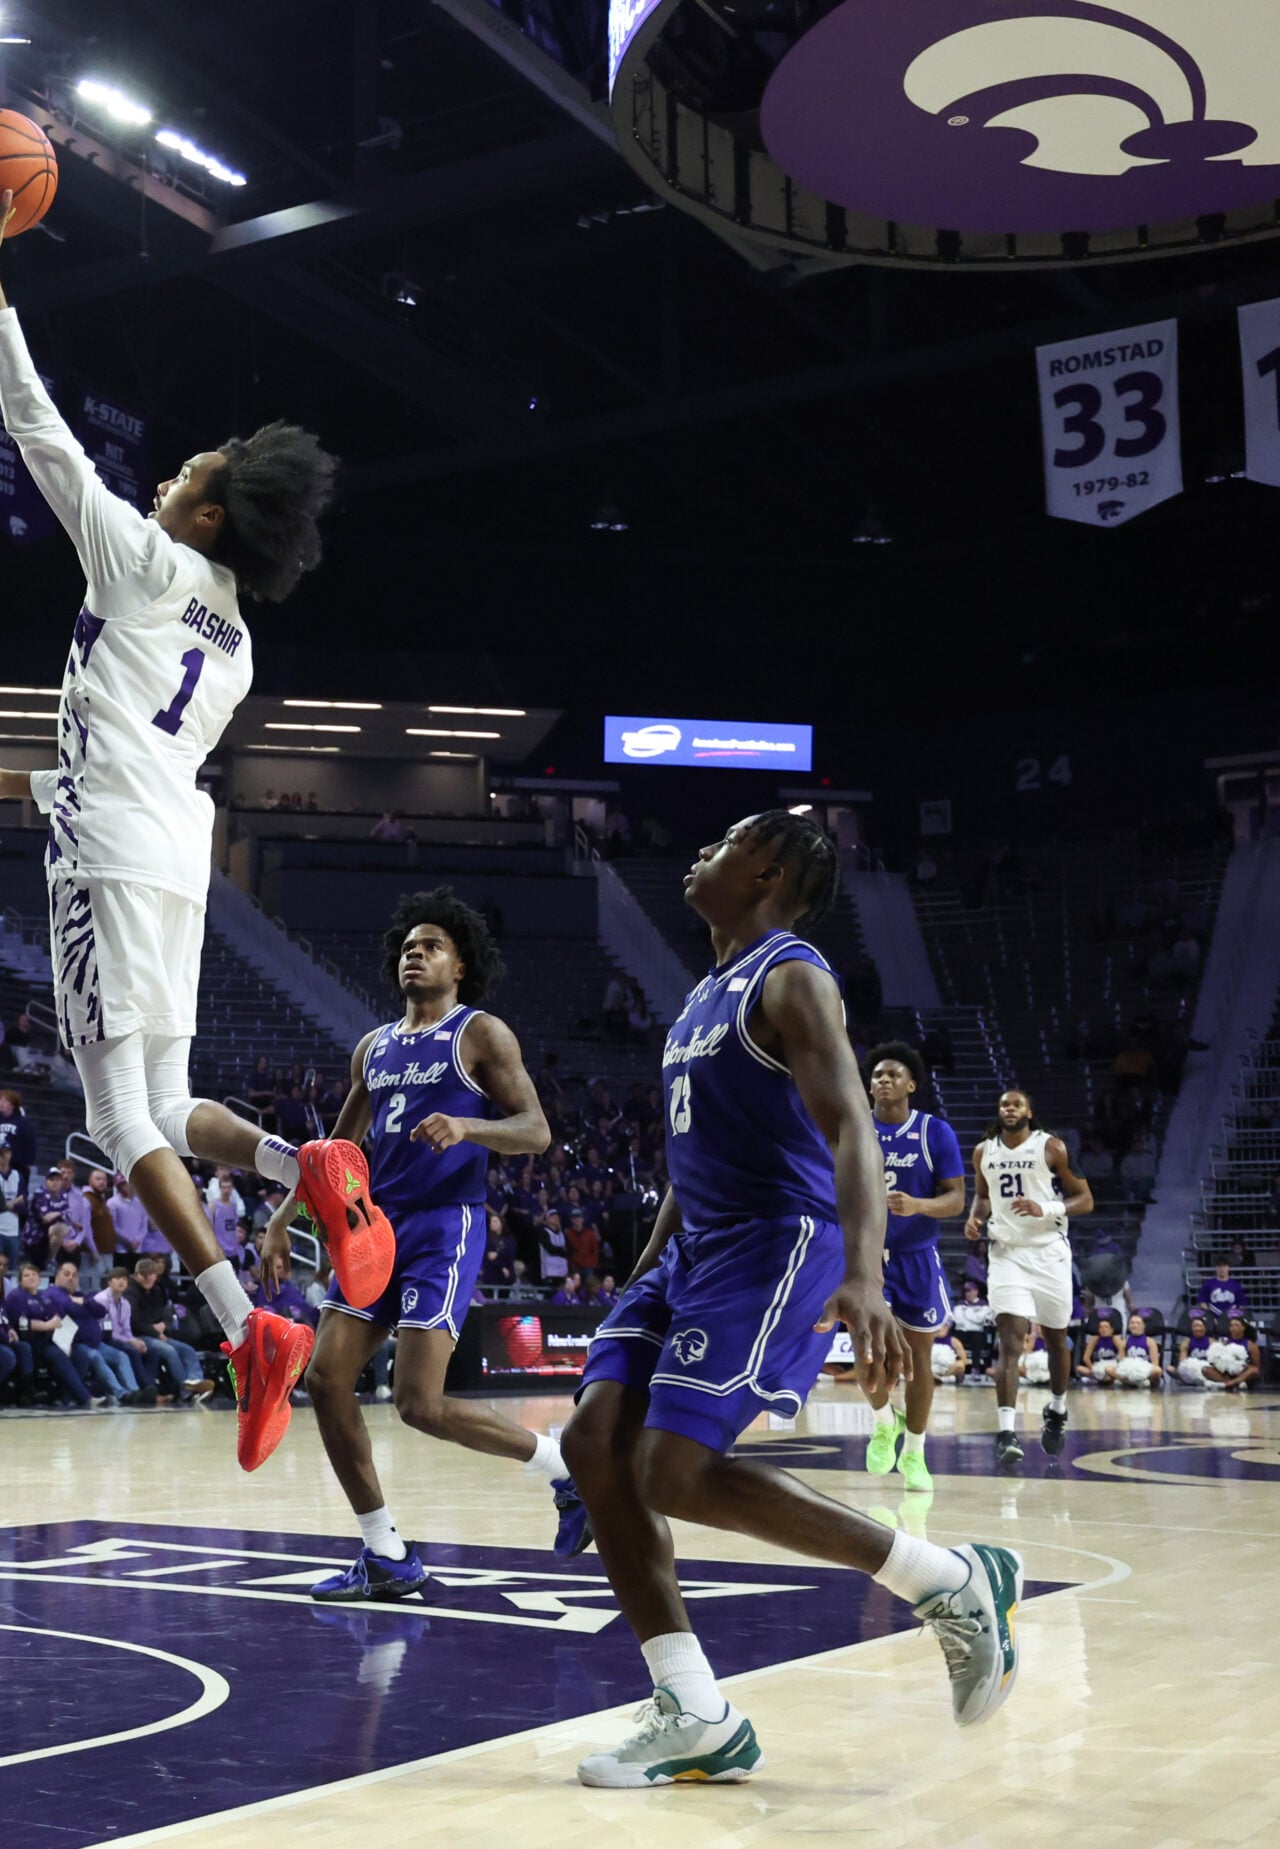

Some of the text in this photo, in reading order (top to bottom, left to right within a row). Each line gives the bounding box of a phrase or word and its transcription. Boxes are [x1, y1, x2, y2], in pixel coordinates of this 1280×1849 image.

[1049, 338, 1164, 377] ROMSTAD
[83, 395, 145, 437] K-STATE
[1053, 371, 1167, 468] 33
[1073, 471, 1150, 497] 1979-82
[181, 597, 243, 657] BASHIR
[151, 647, 205, 736] 1
[367, 1062, 449, 1092] Seton Hall
[385, 1093, 406, 1133] 2
[669, 1072, 692, 1137] 13
[885, 1152, 928, 1167] Hall
[988, 1160, 1036, 1170] K-STATE
[999, 1174, 1024, 1198] 21
